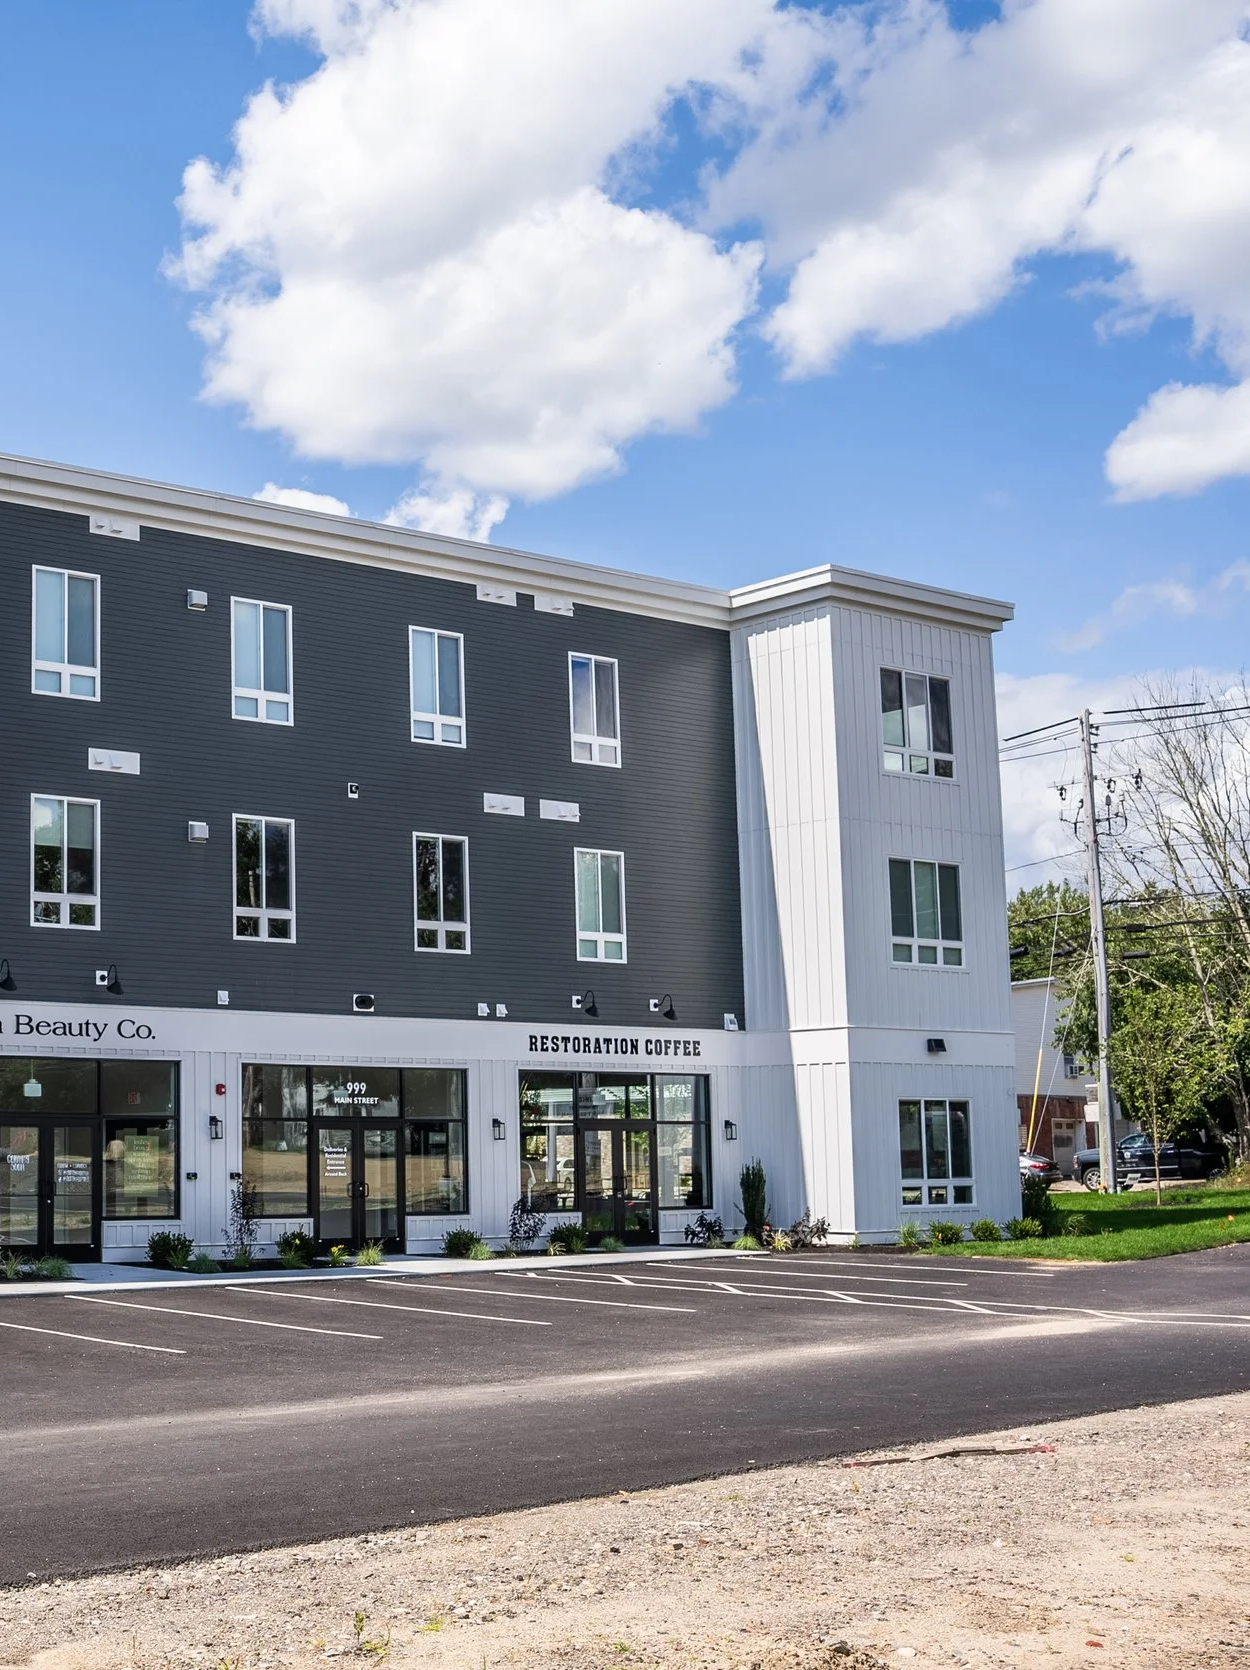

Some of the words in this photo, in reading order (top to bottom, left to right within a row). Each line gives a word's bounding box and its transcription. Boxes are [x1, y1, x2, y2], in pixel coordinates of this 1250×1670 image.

[14, 1014, 109, 1042] Beauty
[117, 1019, 156, 1040] Co.
[529, 1035, 639, 1055] RESTORATION
[645, 1039, 701, 1056] COFFEE
[346, 1082, 367, 1095] 999
[334, 1096, 353, 1104] MAIN
[353, 1097, 379, 1105] STREET
